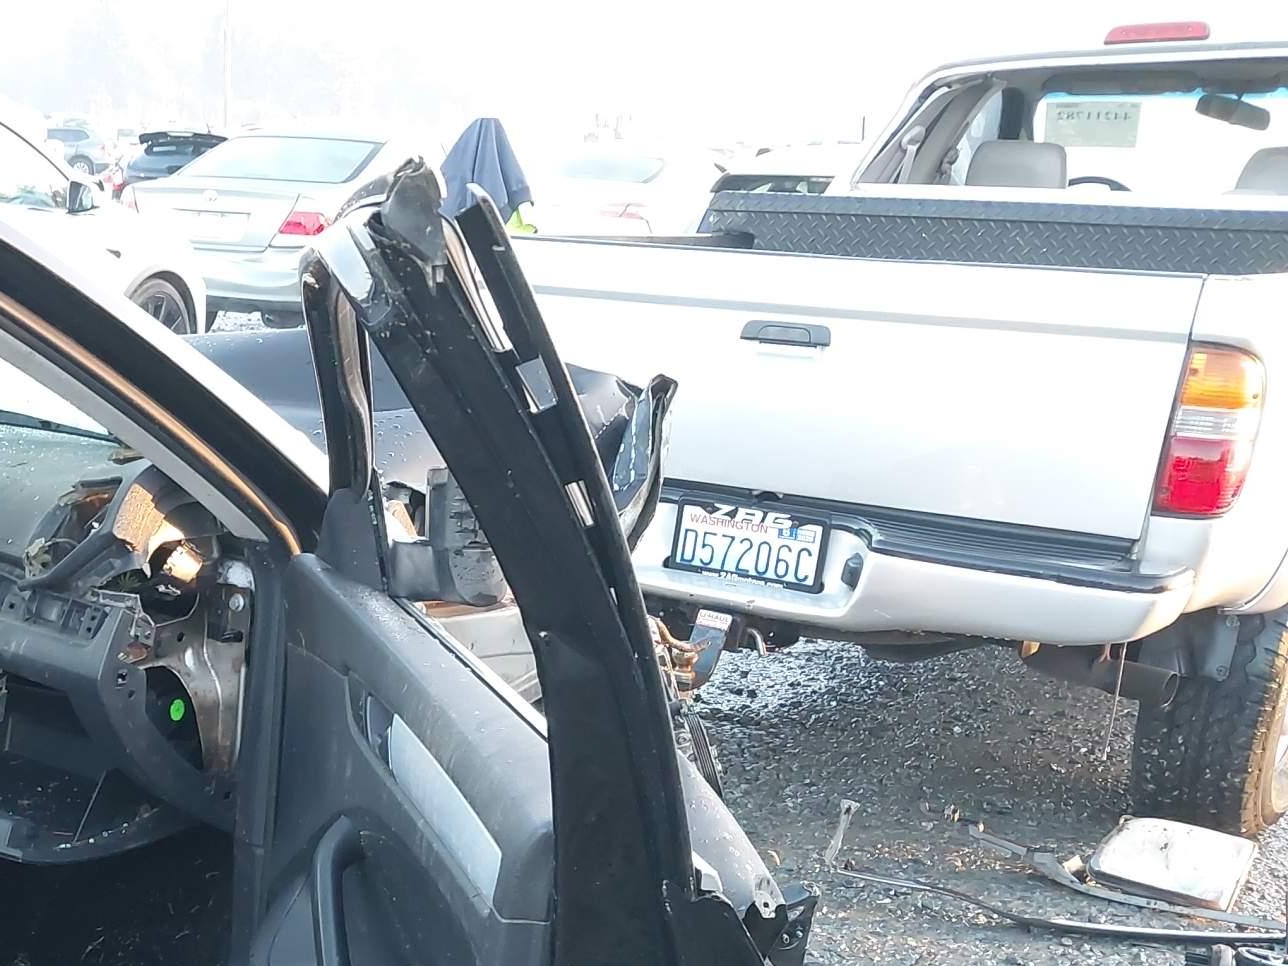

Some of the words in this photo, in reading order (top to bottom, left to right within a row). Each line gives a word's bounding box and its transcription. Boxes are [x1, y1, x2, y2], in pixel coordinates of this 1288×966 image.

[689, 513, 769, 534] WASHINGTON
[711, 503, 793, 529] ZAG
[680, 529, 813, 582] D57206C
